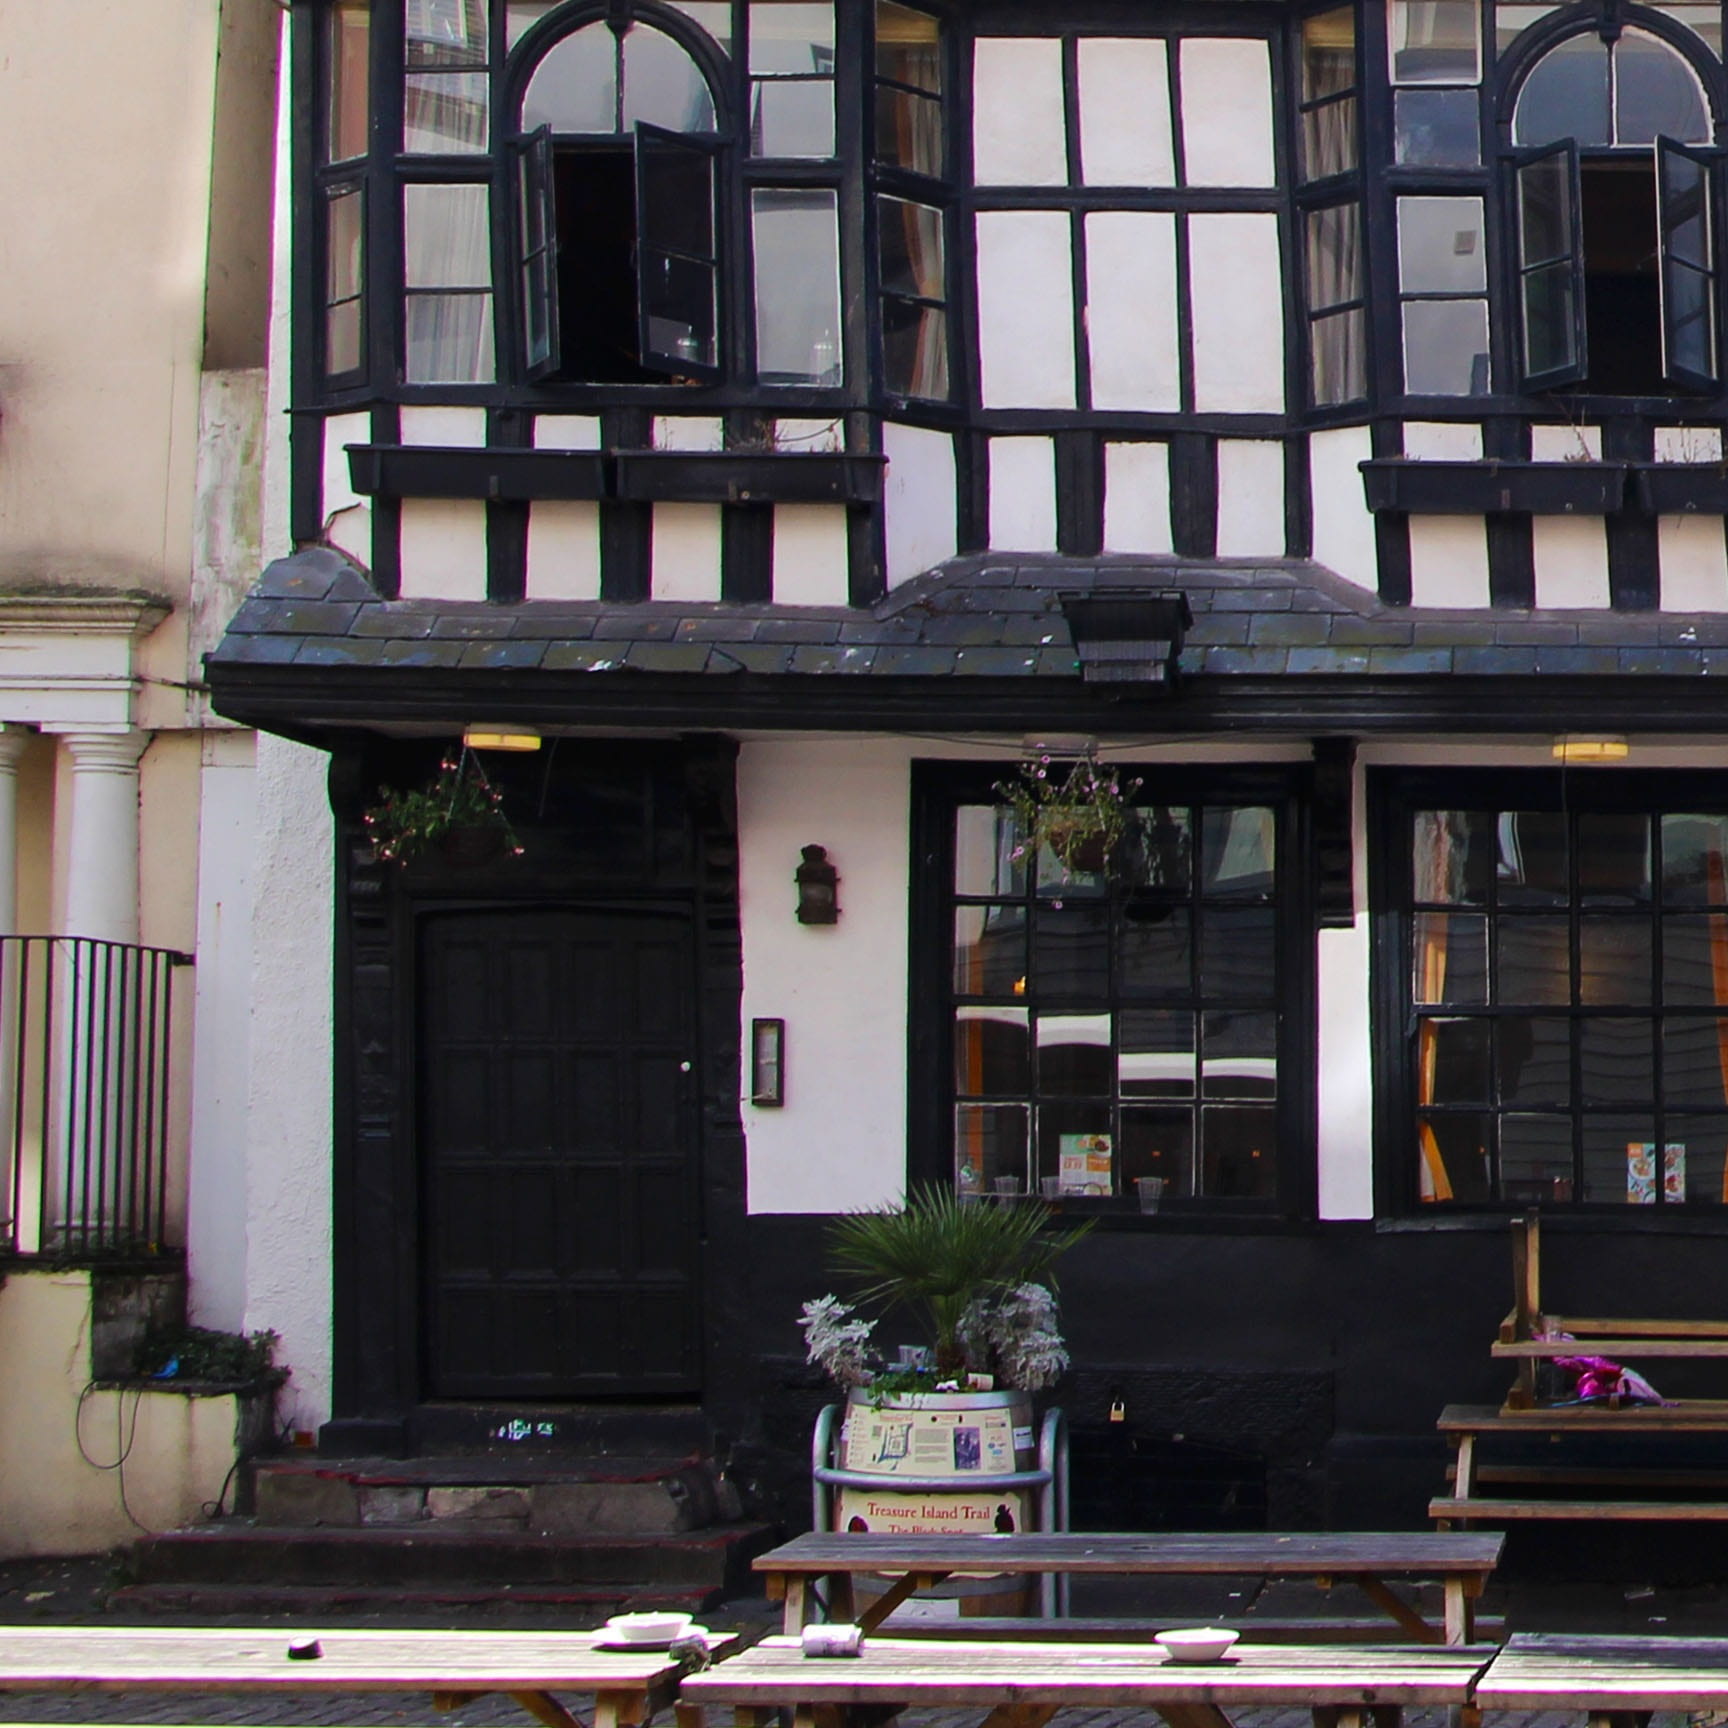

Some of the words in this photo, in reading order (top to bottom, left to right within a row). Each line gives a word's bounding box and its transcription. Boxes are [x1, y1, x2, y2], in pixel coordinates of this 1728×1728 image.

[867, 1502, 917, 1519] Treasure
[921, 1505, 958, 1520] Island
[961, 1505, 990, 1520] Trail
